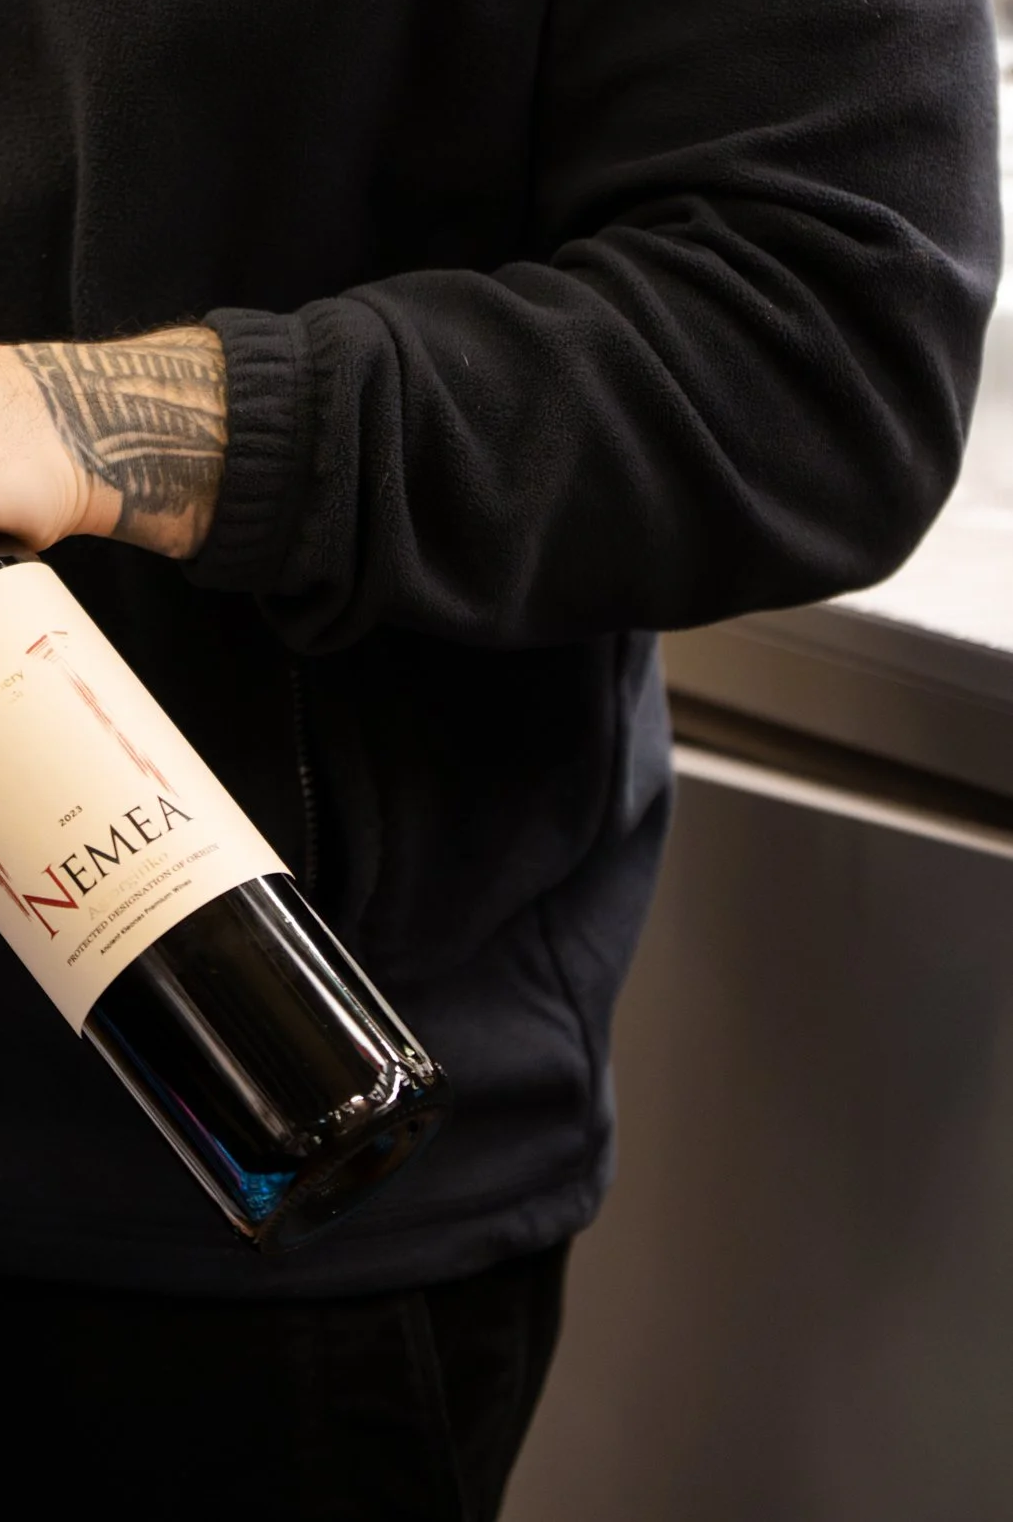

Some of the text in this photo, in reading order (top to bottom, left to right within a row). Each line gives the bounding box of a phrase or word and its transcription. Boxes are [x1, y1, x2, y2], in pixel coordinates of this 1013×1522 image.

[22, 794, 193, 941] NEMEA
[59, 805, 83, 827] 2023
[66, 843, 220, 967] PROTECTED DESIGNATION OF ORIGIN
